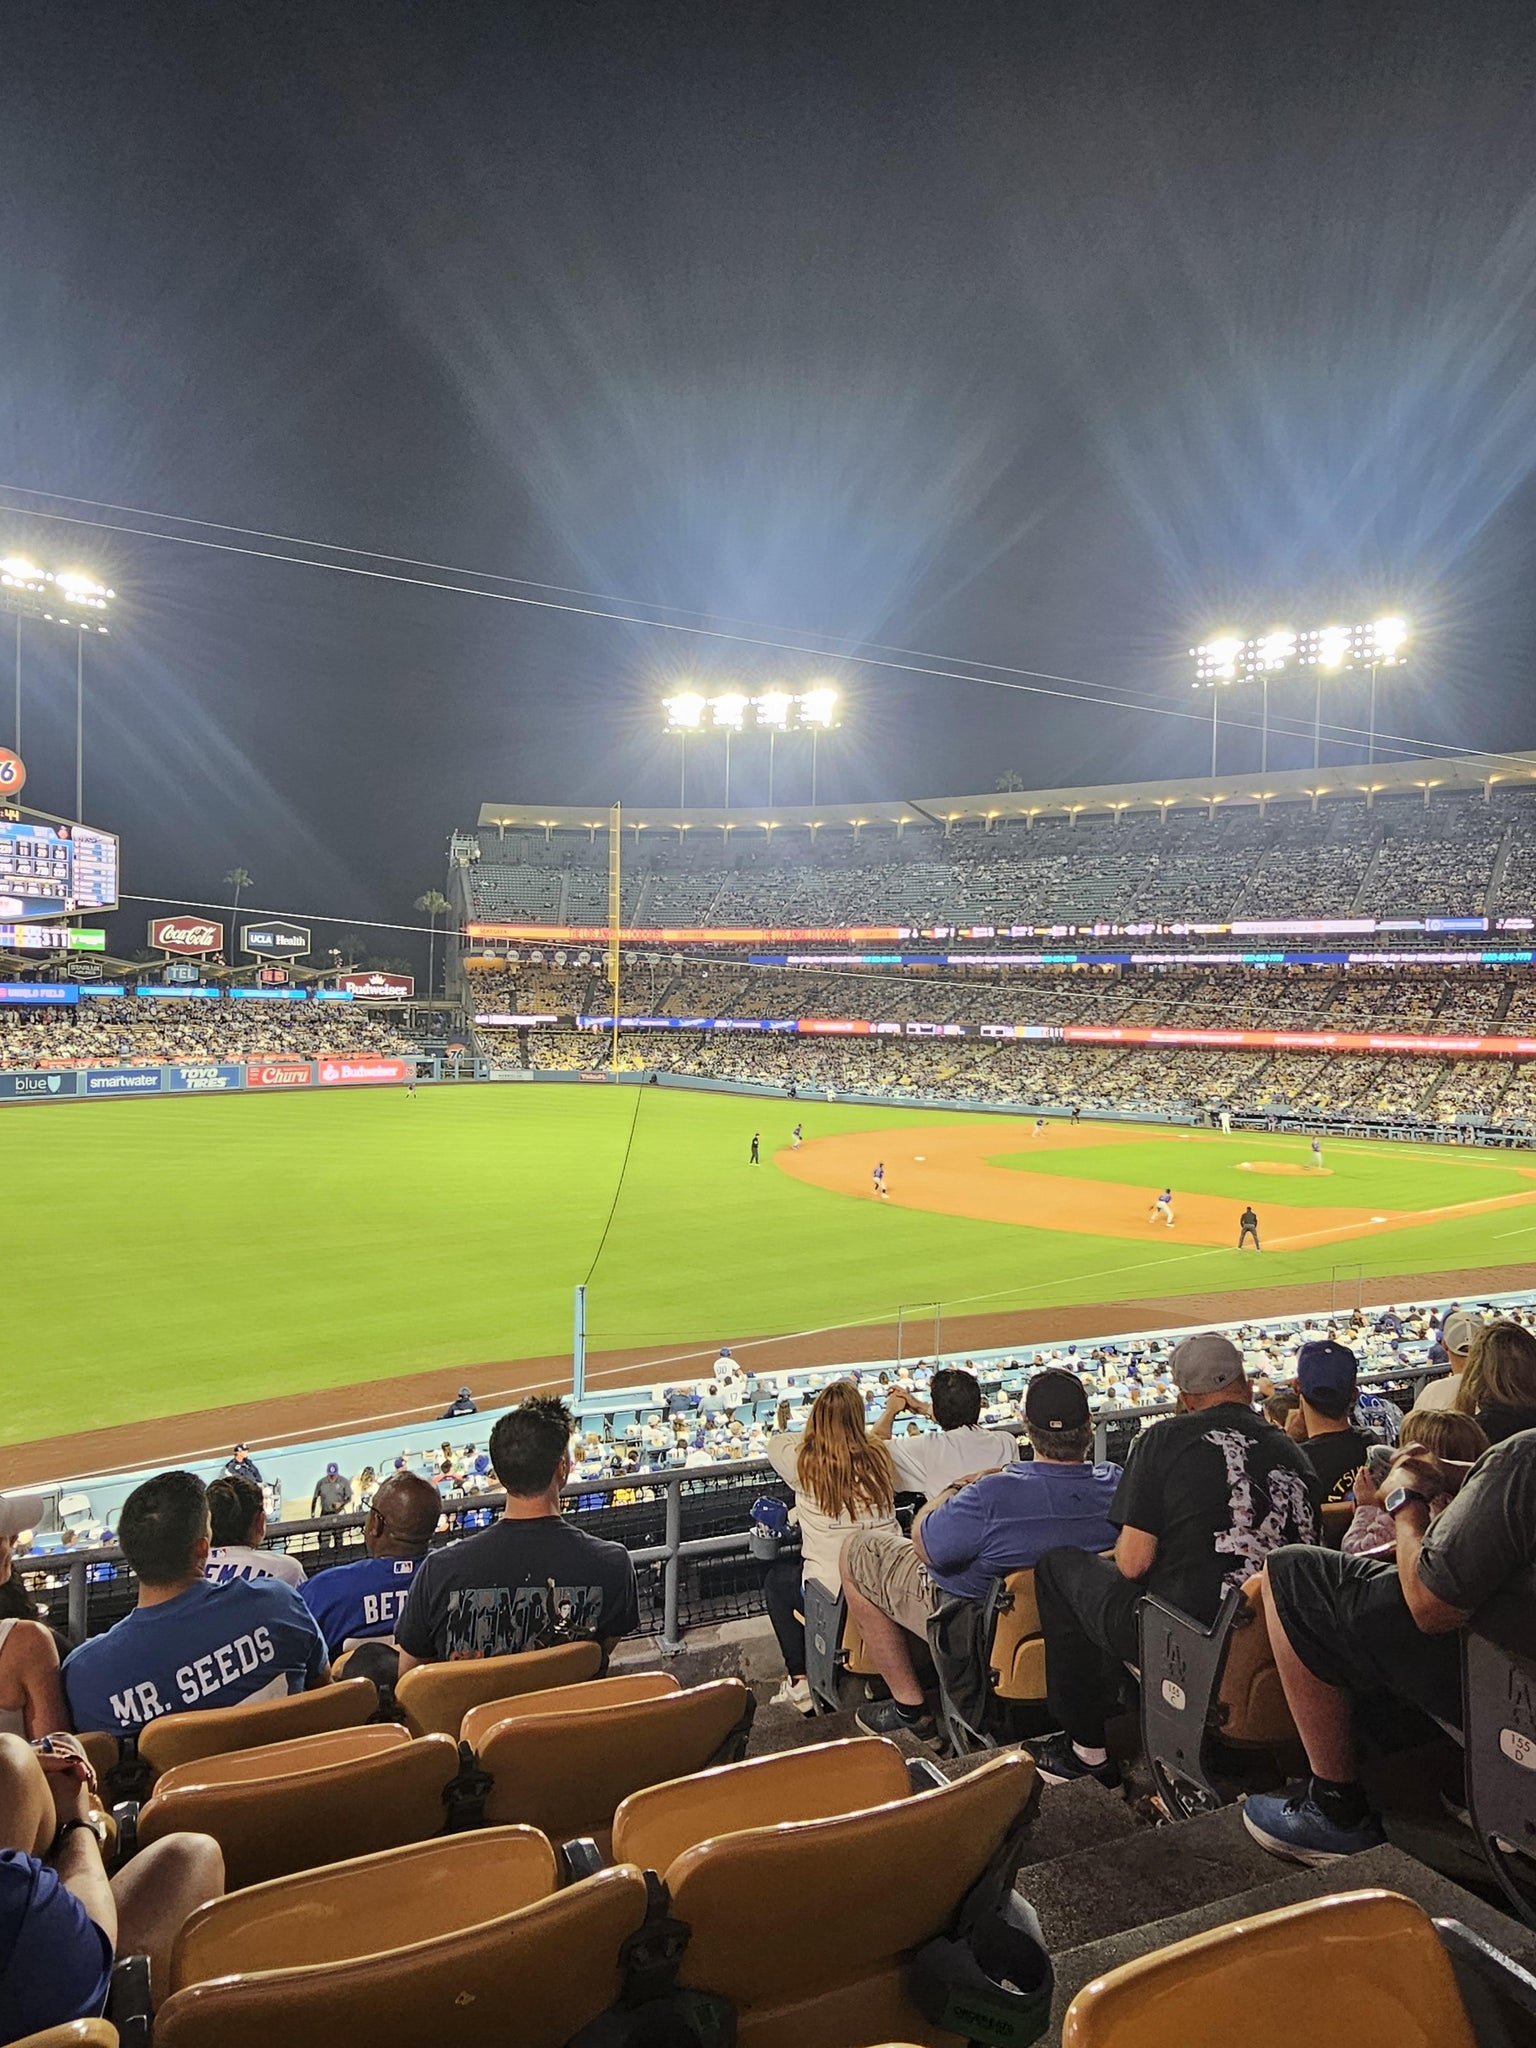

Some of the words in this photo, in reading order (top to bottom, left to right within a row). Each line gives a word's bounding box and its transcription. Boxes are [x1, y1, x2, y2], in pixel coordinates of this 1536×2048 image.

[0, 761, 15, 783] 6
[250, 934, 273, 944] UCLA
[275, 934, 305, 946] Health
[172, 968, 194, 979] TEL
[346, 981, 408, 996] Budweiser
[180, 1068, 219, 1079] TOYO
[262, 1067, 309, 1084] Churu
[15, 1077, 47, 1090] blue
[90, 1074, 158, 1089] smartwater
[186, 1078, 228, 1088] TIRES
[109, 1681, 172, 1727] MR.
[175, 1625, 275, 1704] SEEDS
[1511, 1733, 1531, 1753] 155
